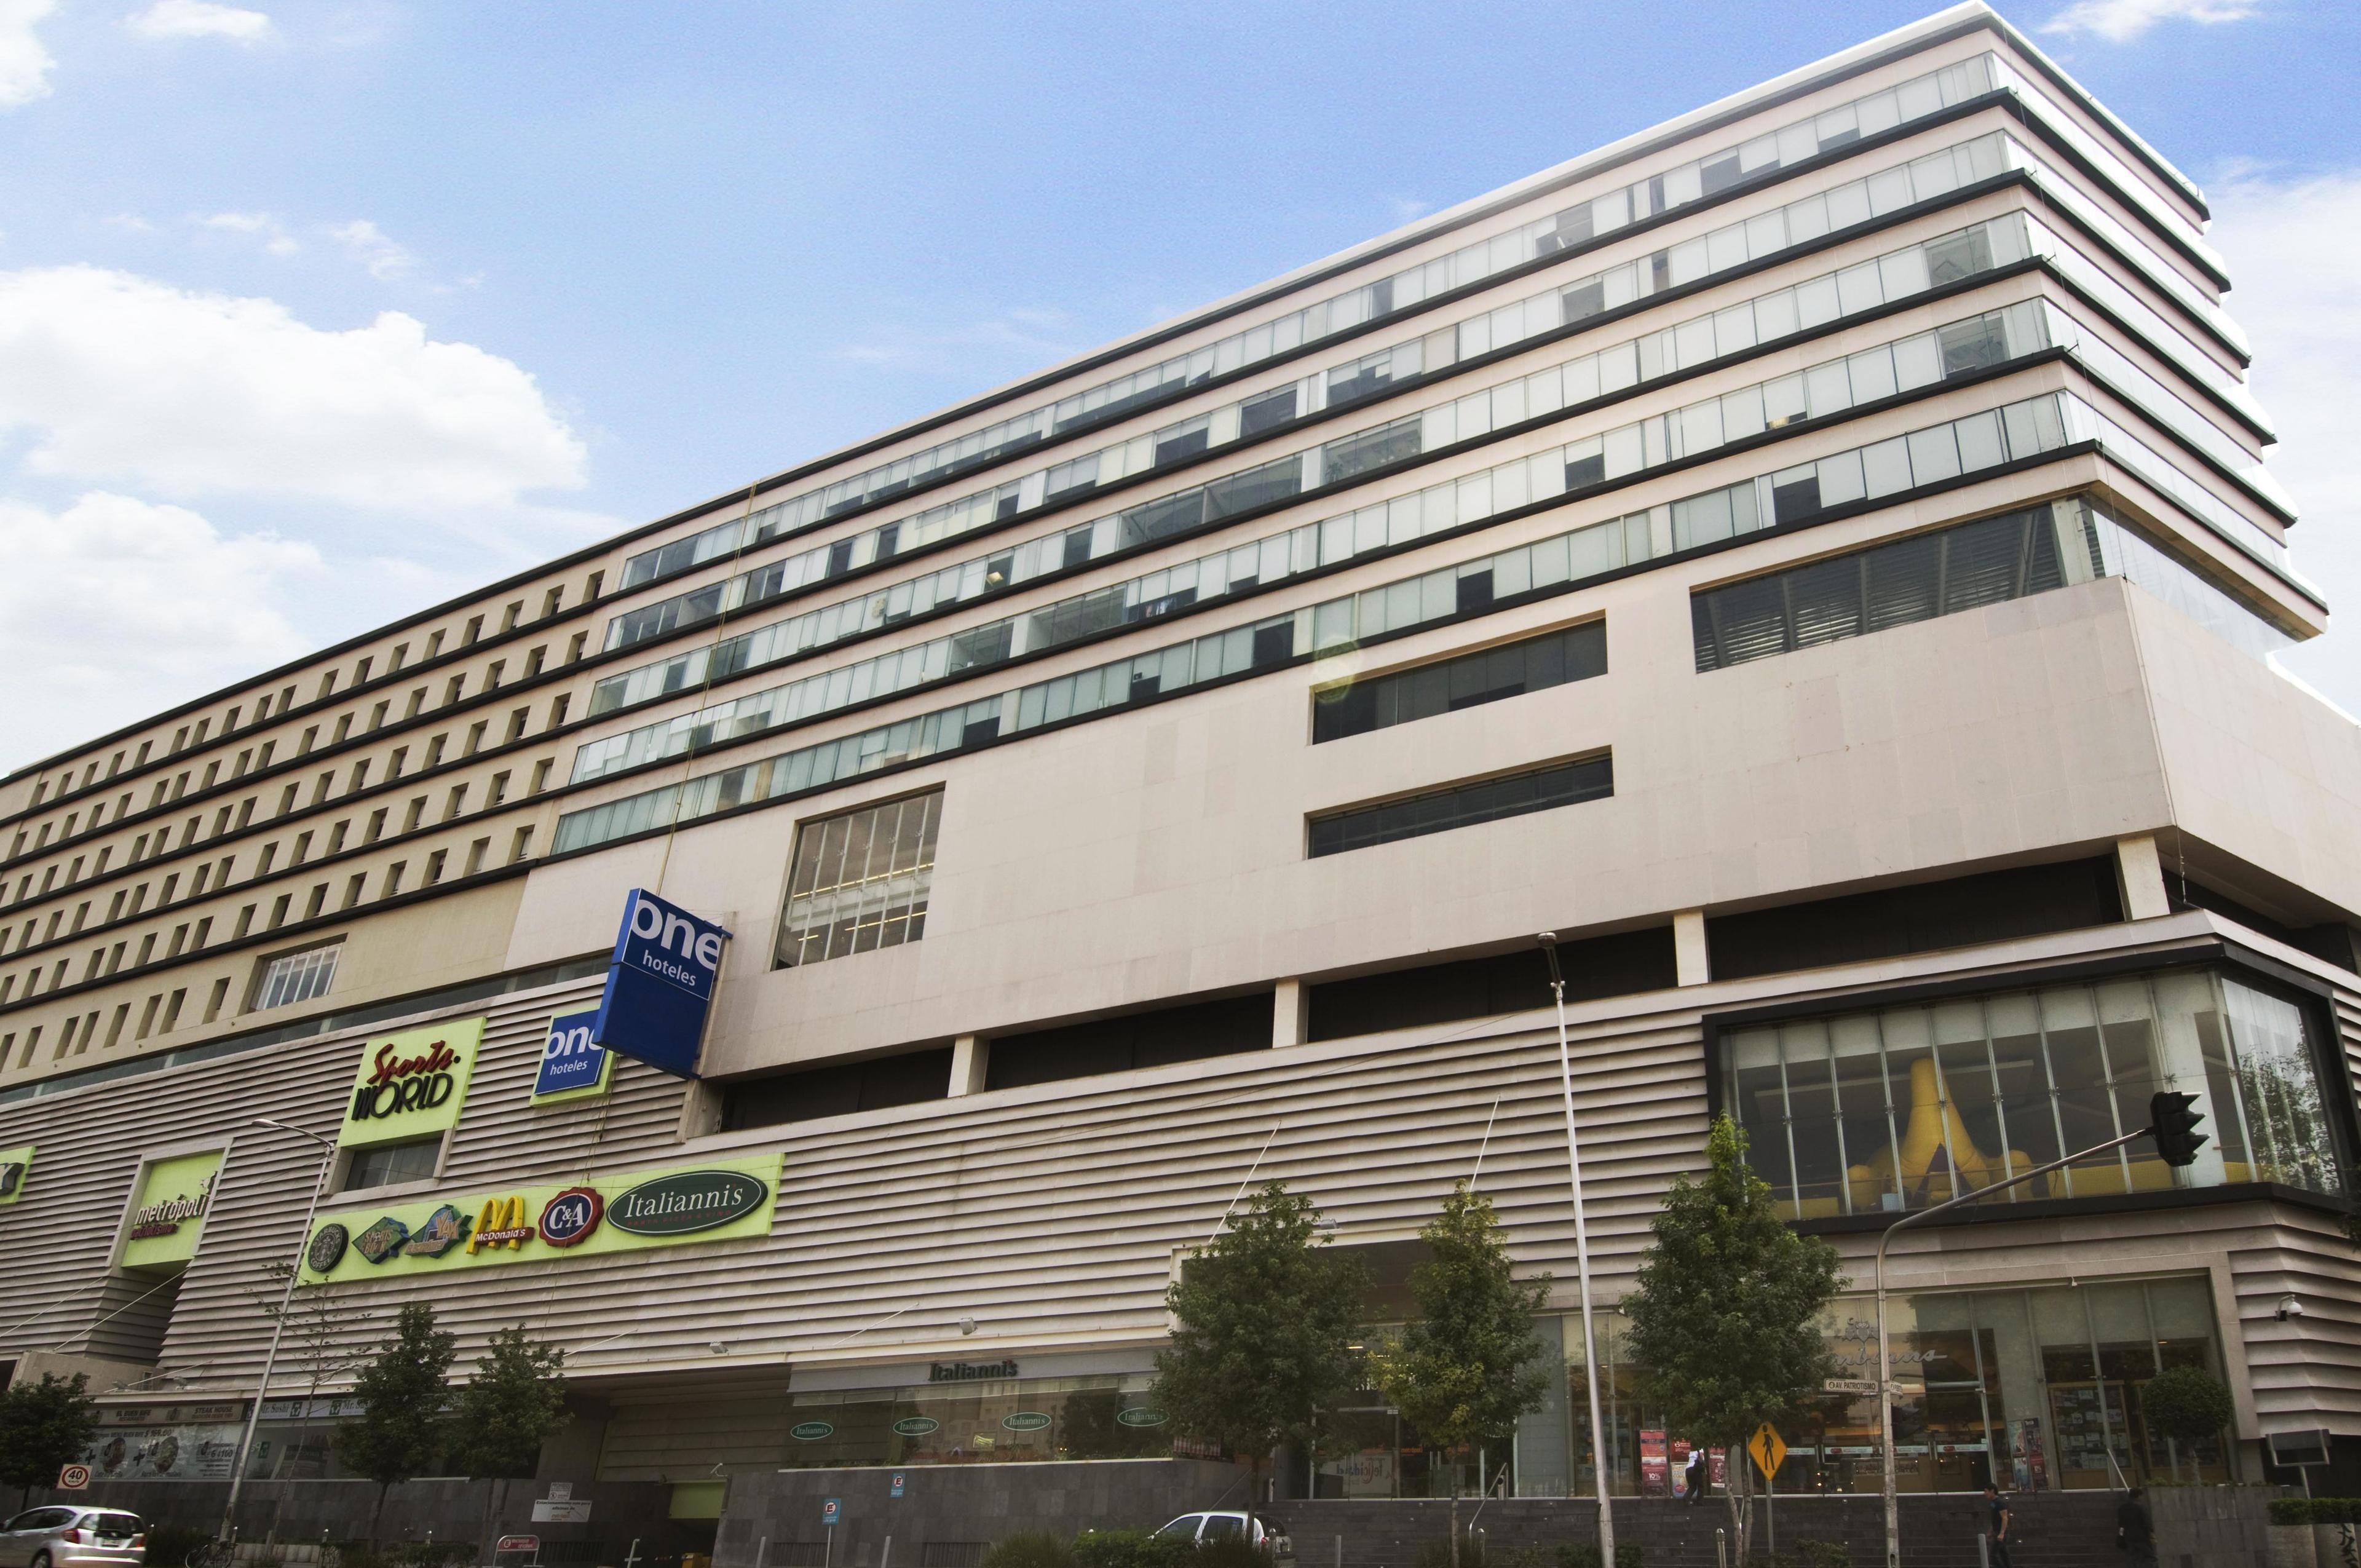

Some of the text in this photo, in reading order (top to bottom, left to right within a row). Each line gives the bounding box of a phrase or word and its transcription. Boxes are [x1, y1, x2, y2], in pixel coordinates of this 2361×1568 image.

[631, 899, 722, 970] one
[643, 949, 696, 986] hoteles
[366, 1040, 454, 1094] Sports
[550, 1059, 588, 1076] hoteles
[351, 1072, 453, 1121] WORLD
[549, 1203, 585, 1229] C&A
[475, 1229, 526, 1242] McDonald's
[310, 1257, 330, 1269] COFFEE
[271, 1403, 290, 1412] Sushi
[68, 1470, 83, 1479] 40
